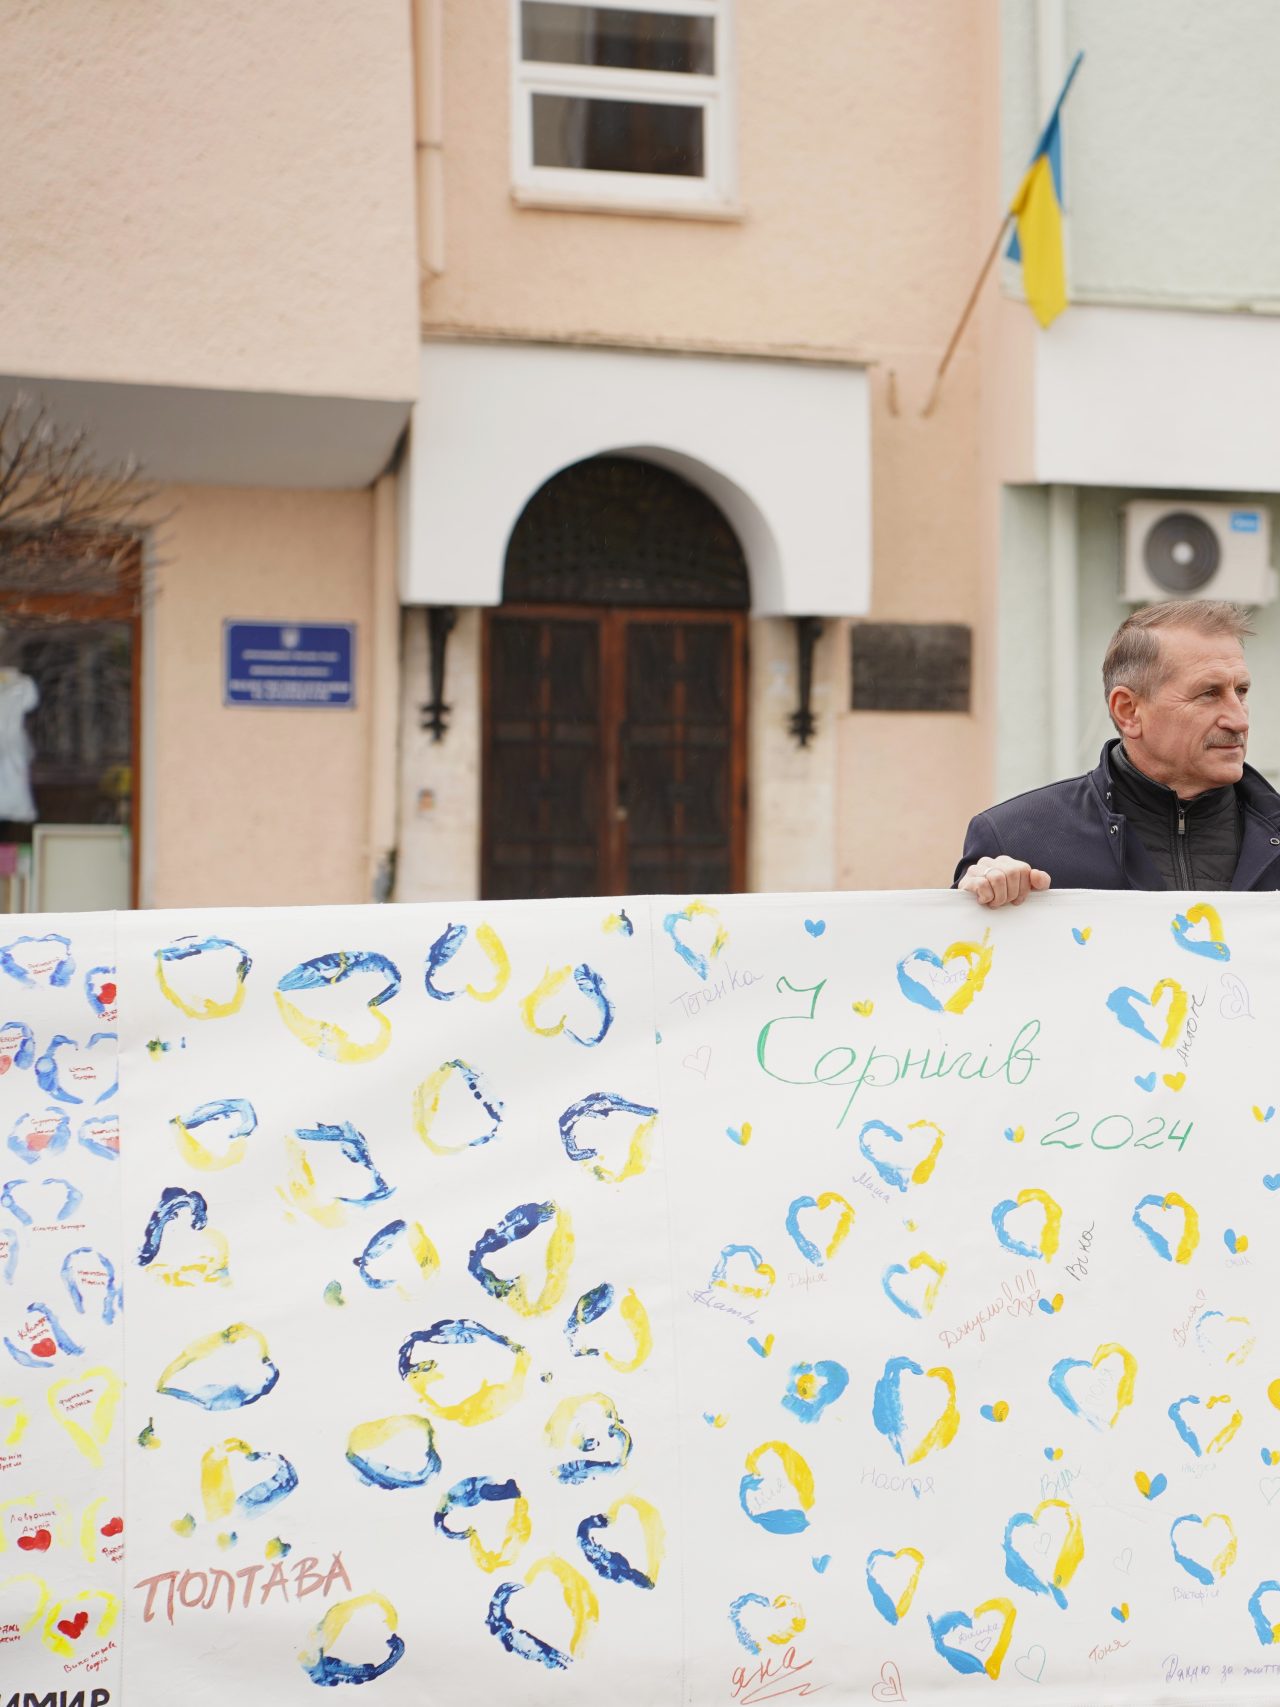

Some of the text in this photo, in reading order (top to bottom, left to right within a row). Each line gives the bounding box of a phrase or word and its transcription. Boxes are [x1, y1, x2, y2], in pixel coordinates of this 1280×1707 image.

[757, 975, 1041, 1130] Чернігів
[1040, 1111, 1194, 1152] 2024
[134, 1551, 353, 1626] ПОЛТАВА
